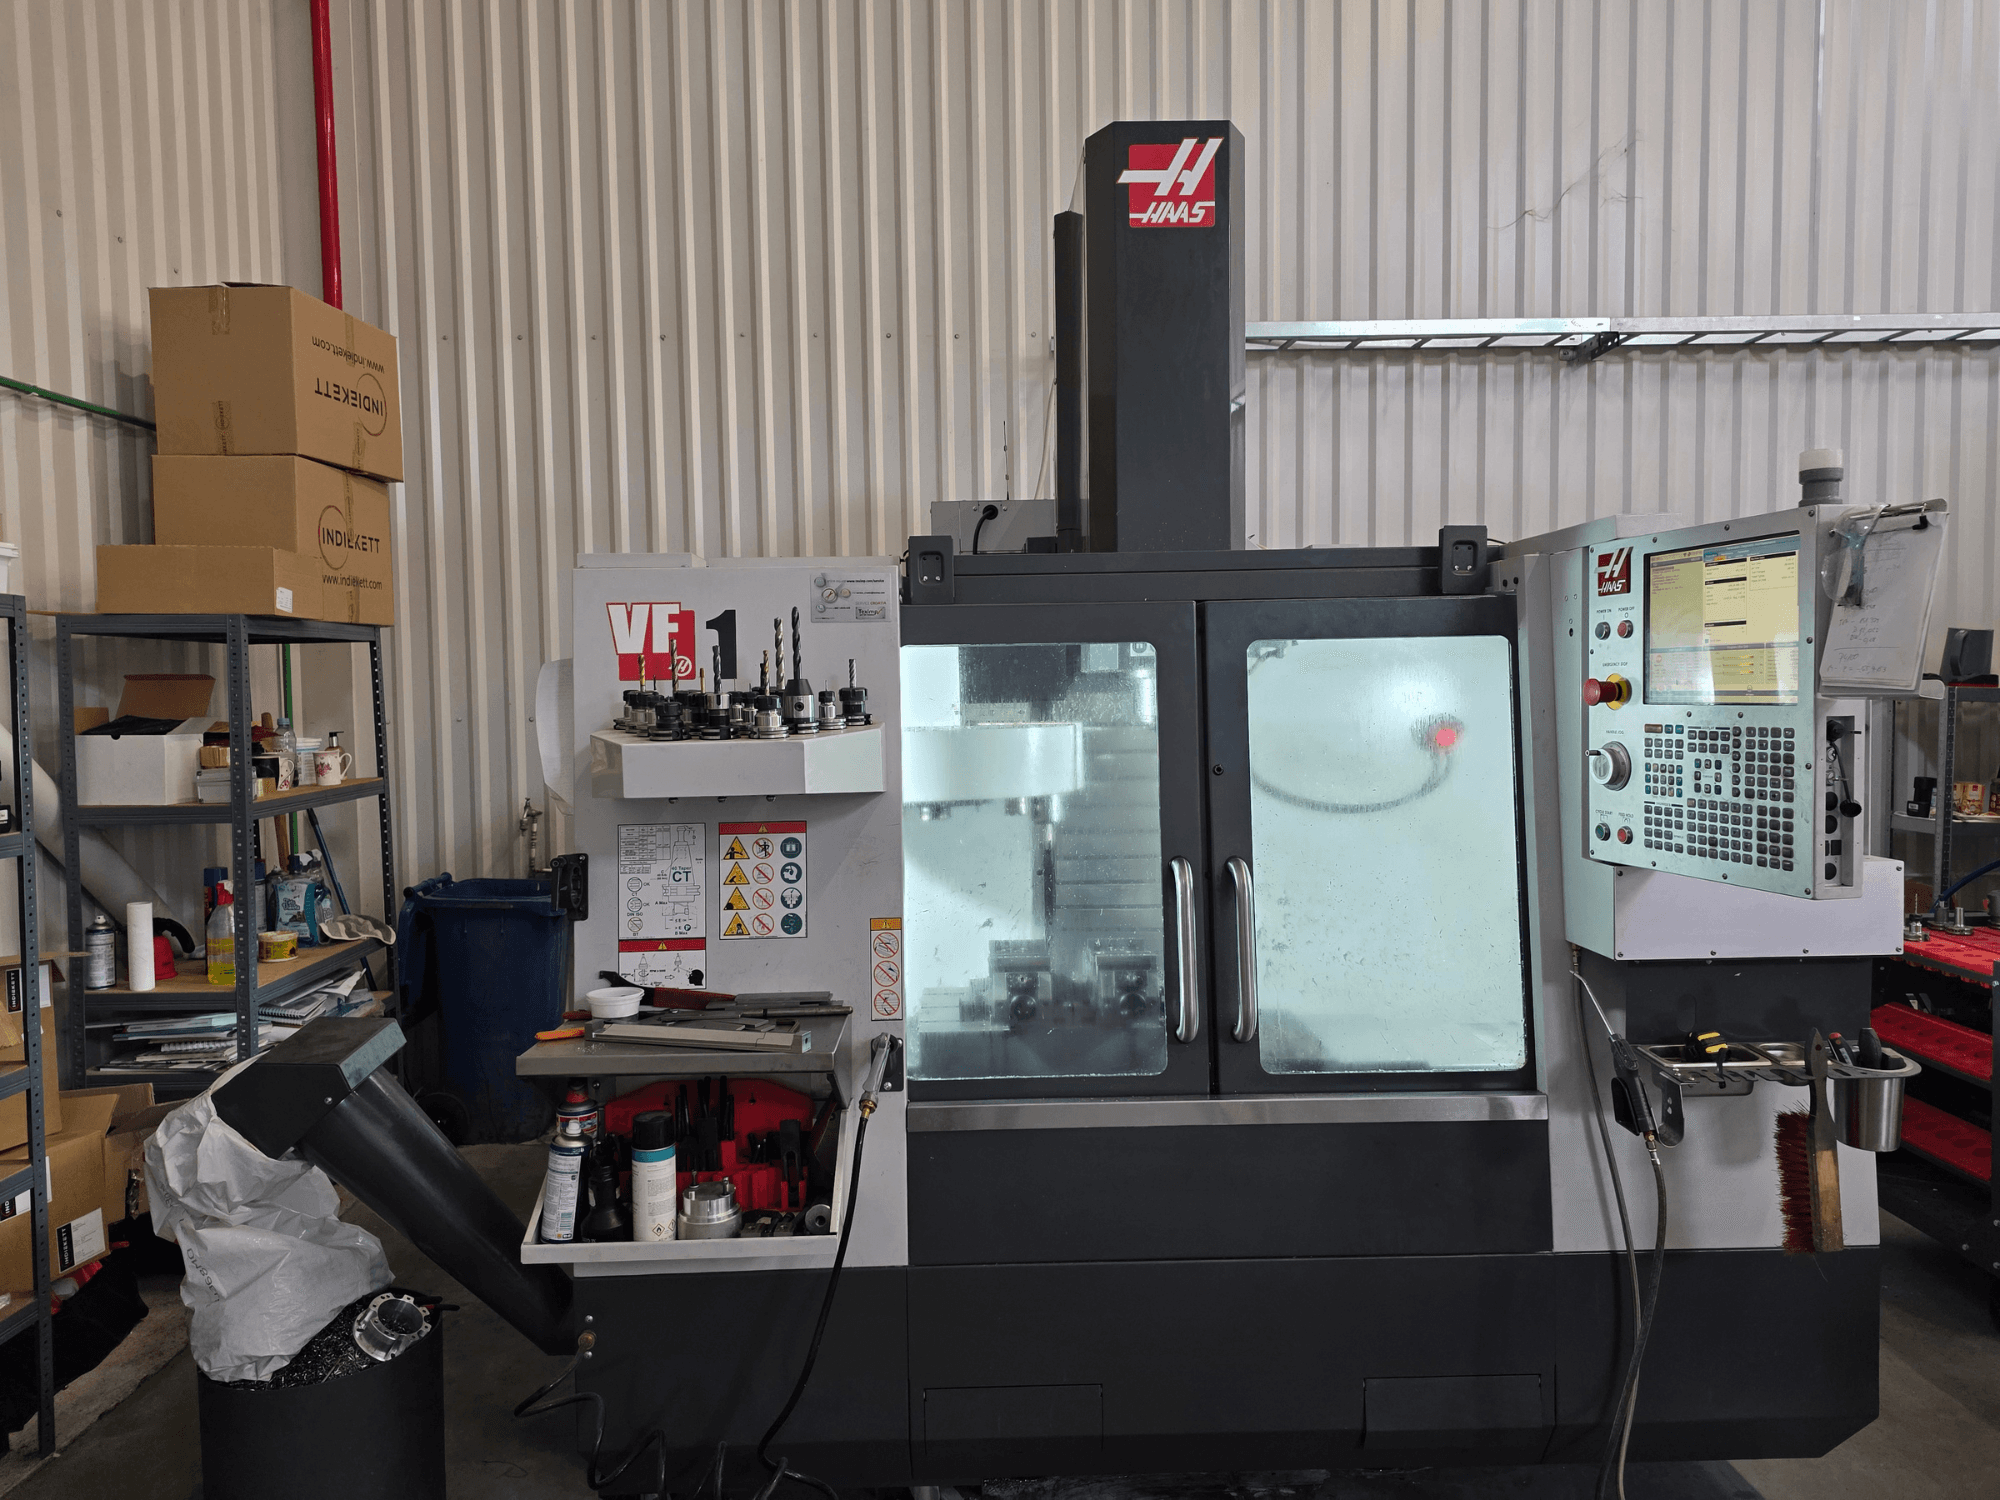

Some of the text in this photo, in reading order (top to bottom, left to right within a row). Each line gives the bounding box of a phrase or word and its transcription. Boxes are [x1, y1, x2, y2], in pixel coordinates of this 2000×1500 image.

[1130, 201, 1215, 224] HAAS
[312, 336, 384, 374] www.indiekett.com
[314, 377, 384, 417] INDIEKETT
[322, 573, 383, 591] www.indiekett.com
[1598, 580, 1626, 593] HAAS
[606, 602, 738, 680] VF 1
[672, 870, 692, 883] CT
